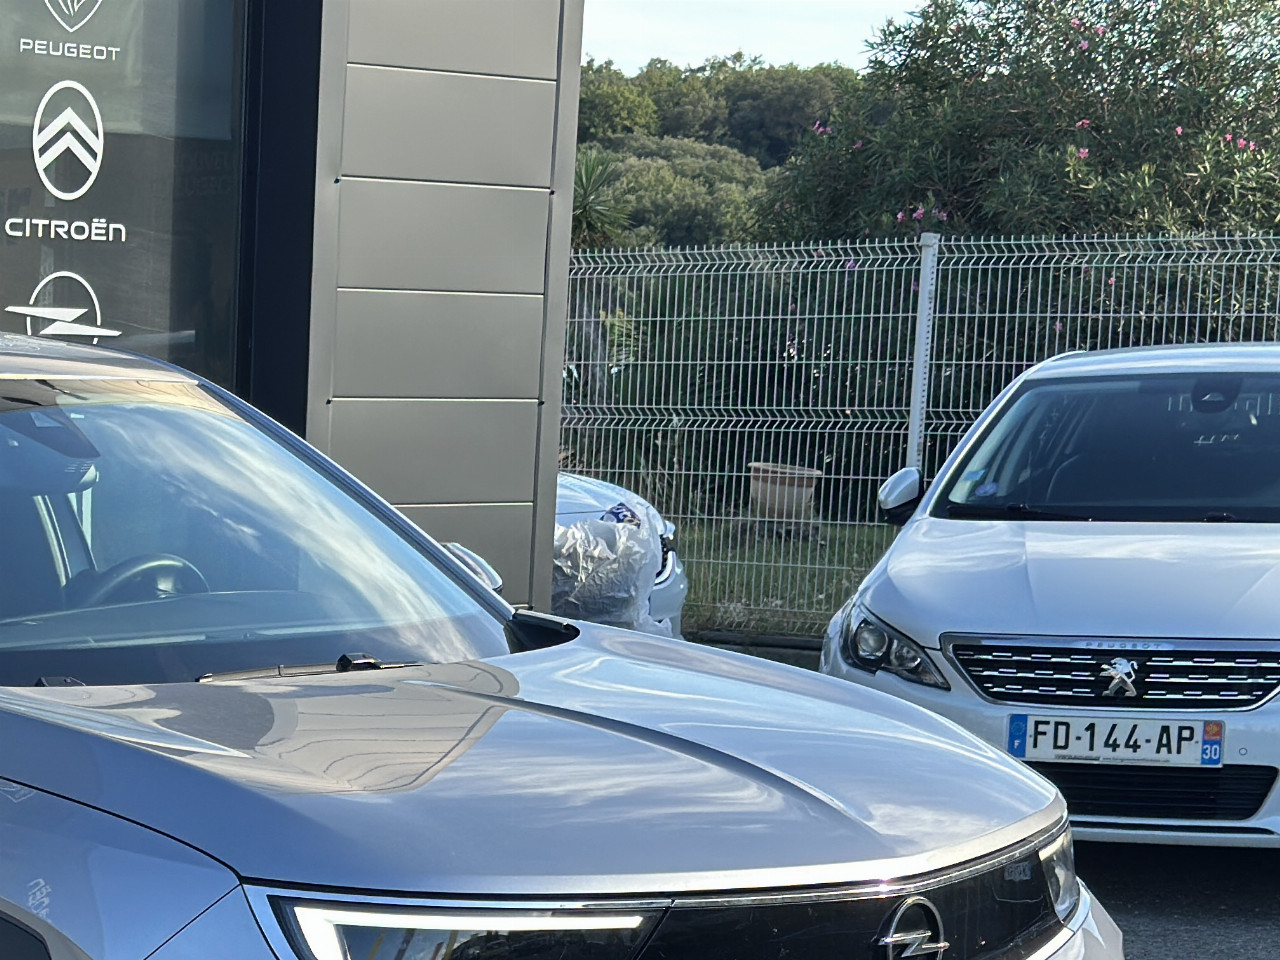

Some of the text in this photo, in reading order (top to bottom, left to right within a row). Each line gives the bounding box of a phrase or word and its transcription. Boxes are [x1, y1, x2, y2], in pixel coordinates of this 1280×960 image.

[20, 38, 120, 61] PEUGEOT
[1032, 720, 1195, 755] FD-144-AP
[1202, 744, 1220, 760] 30
